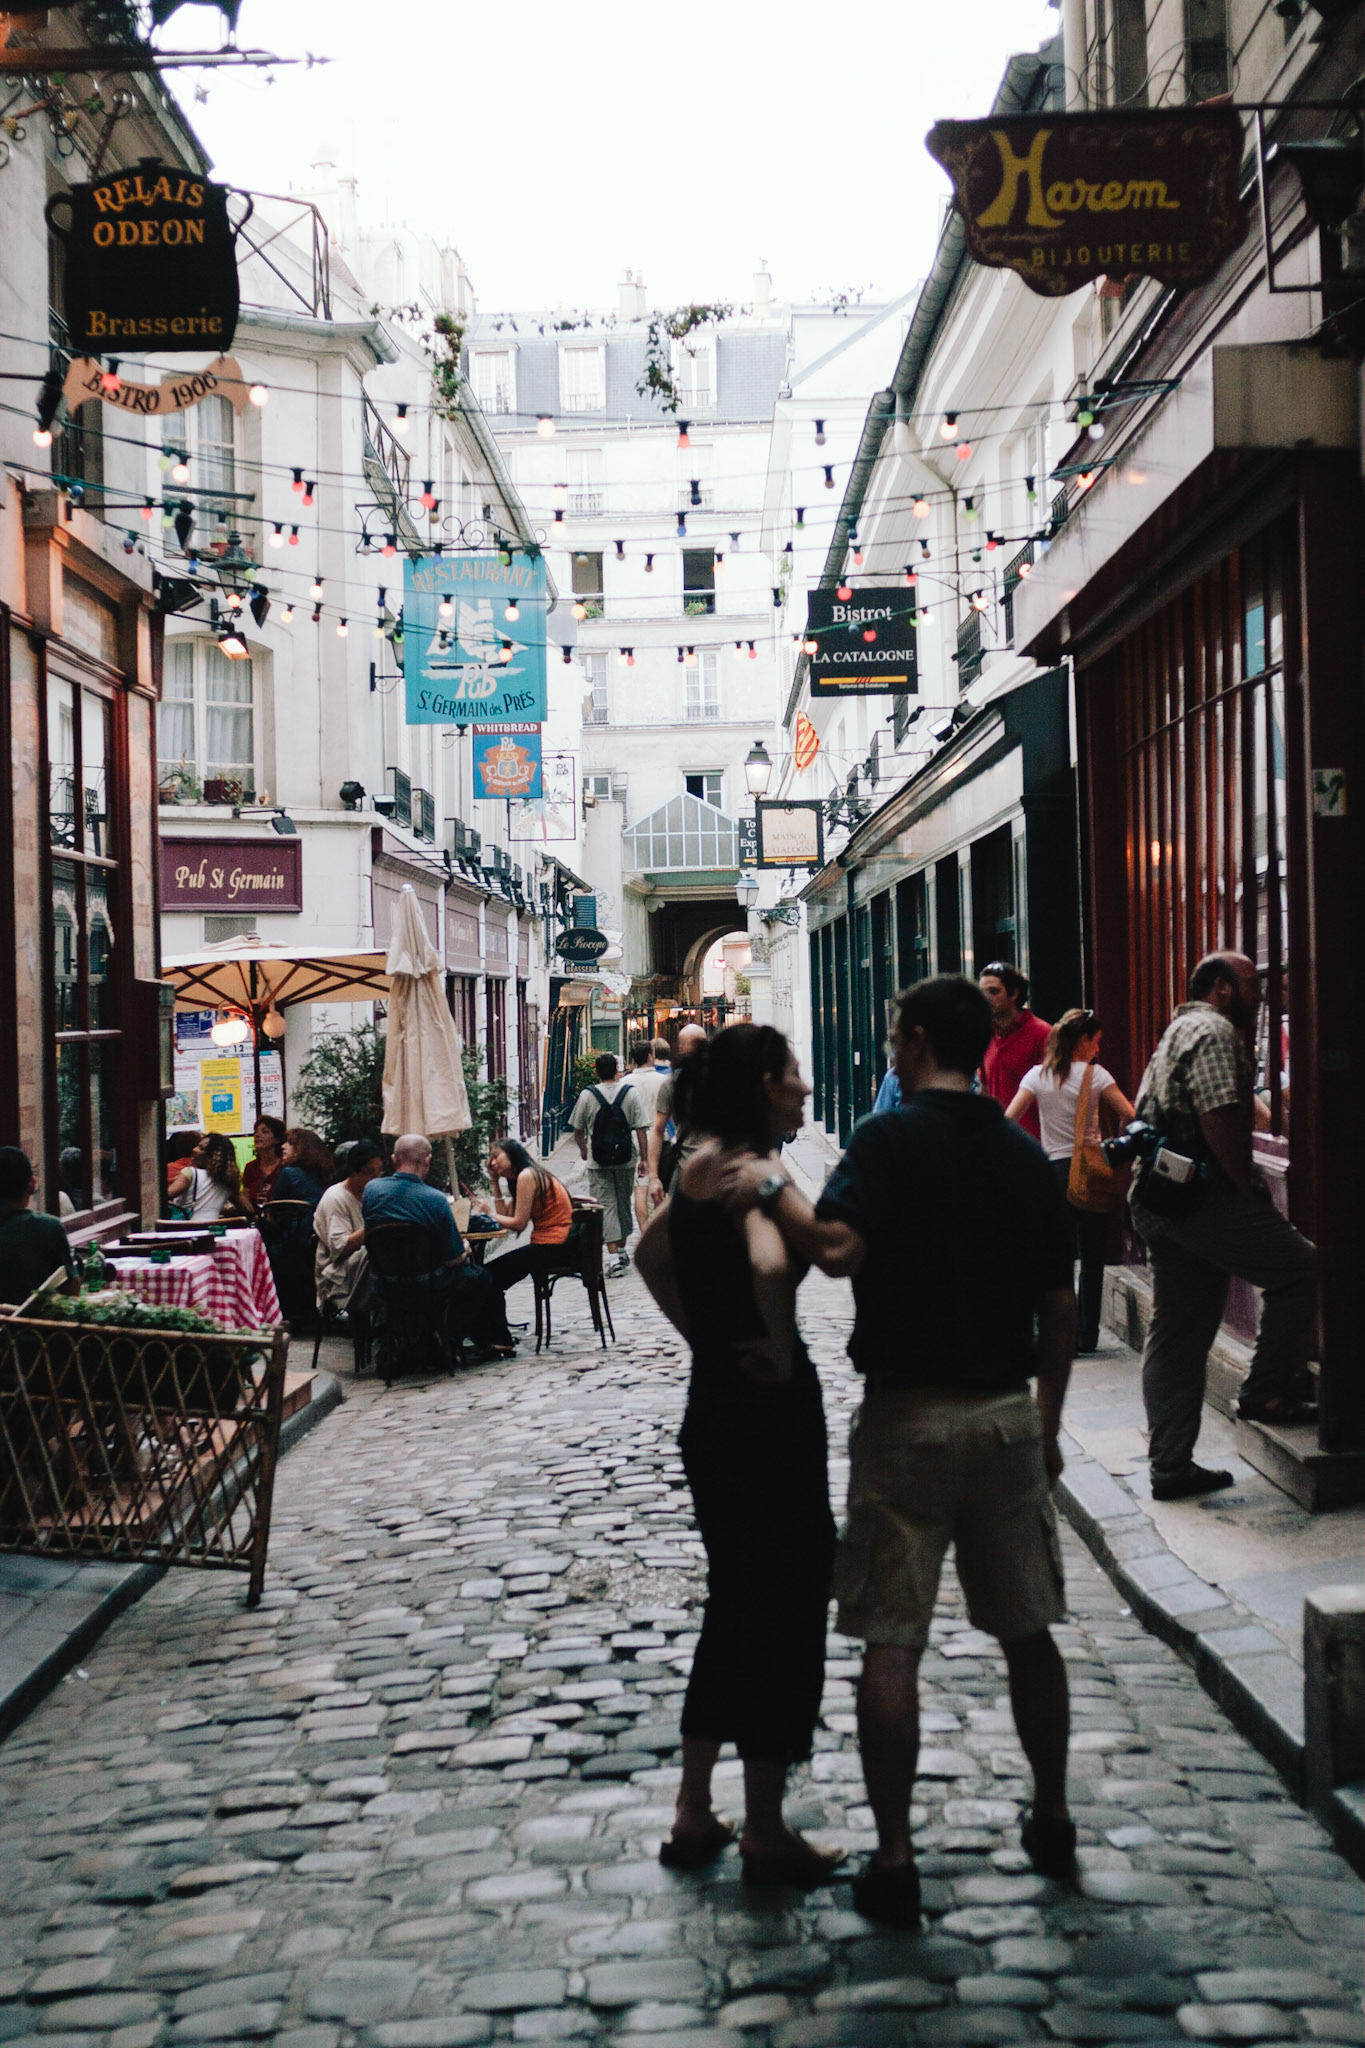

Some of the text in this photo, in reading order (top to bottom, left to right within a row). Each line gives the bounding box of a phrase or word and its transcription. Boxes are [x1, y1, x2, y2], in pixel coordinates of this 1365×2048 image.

[975, 129, 1181, 228] Harem
[93, 176, 205, 212] RELAIS
[93, 218, 205, 247] ODEON
[1032, 243, 1192, 267] BIJOUTERIE
[86, 307, 222, 337] Brasserie
[411, 560, 537, 593] RESTAURANT
[832, 604, 892, 622] Bistrot
[812, 650, 914, 663] LA CATALOGNE
[454, 664, 498, 699] Pub
[432, 693, 488, 719] GERMAIN
[489, 701, 503, 715] des
[503, 690, 535, 713] PRÉS
[476, 723, 538, 733] WHITBREAD
[500, 736, 516, 752] Pub
[764, 845, 815, 855] CATALOGNE
[175, 859, 285, 899] Pub St Germain
[249, 1101, 278, 1109] MZART
